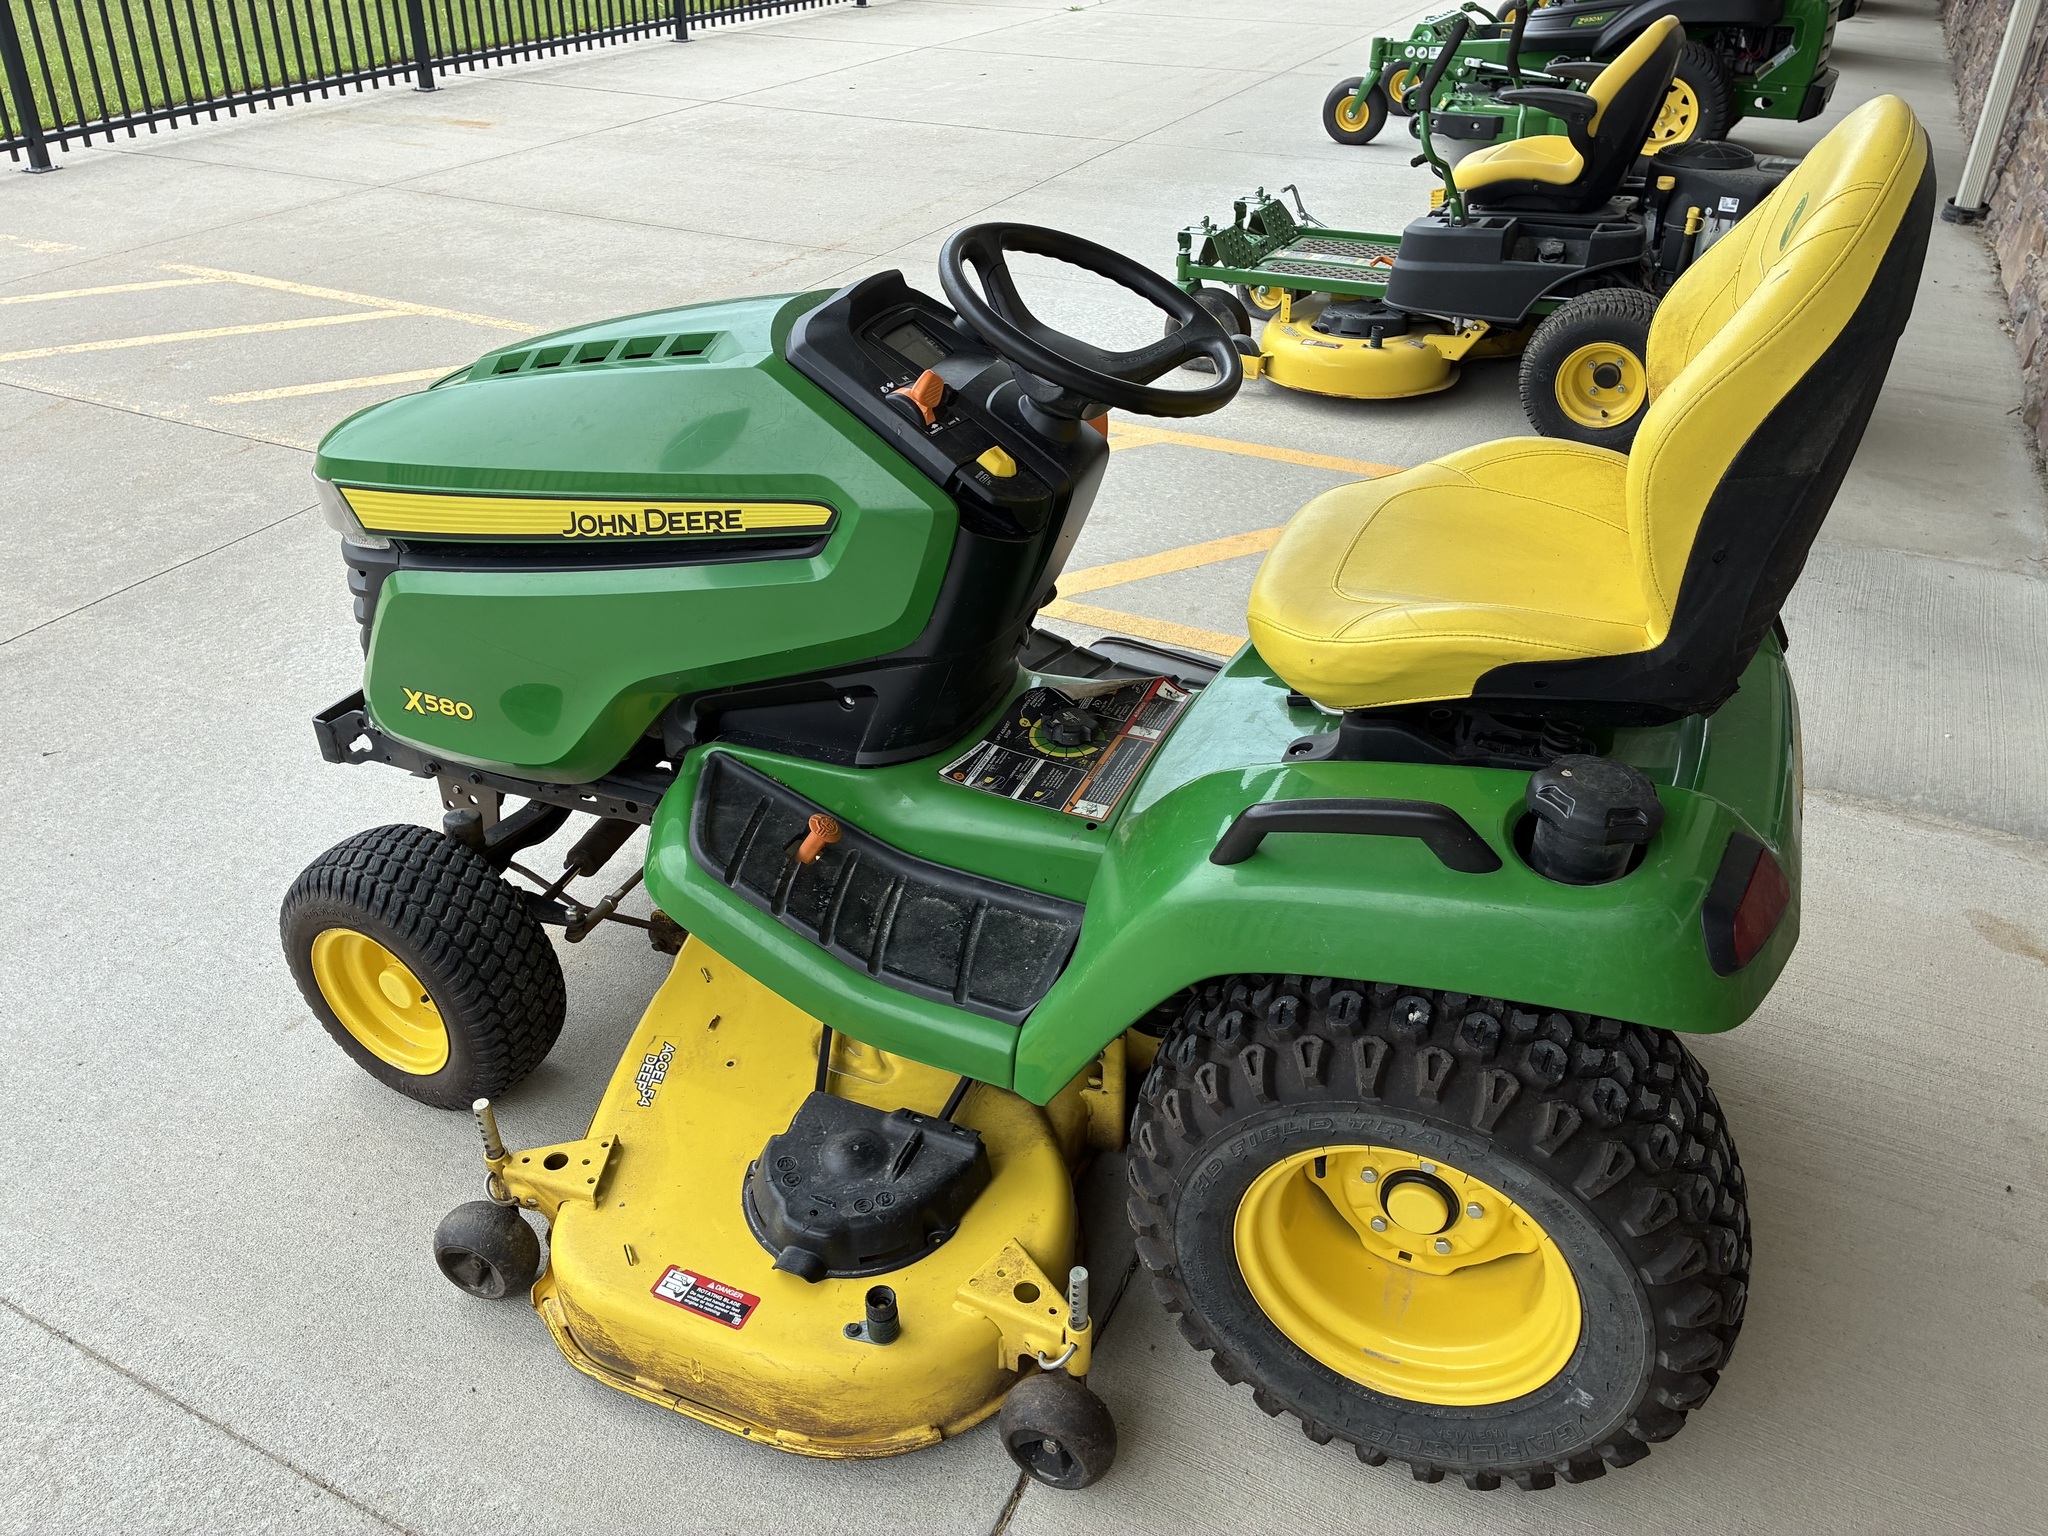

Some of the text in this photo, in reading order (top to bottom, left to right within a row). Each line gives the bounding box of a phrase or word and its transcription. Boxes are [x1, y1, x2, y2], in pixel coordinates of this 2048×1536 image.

[563, 509, 743, 534] JOHN DEERE
[401, 687, 474, 721] X580
[634, 1053, 658, 1091] DEEP
[637, 1041, 676, 1107] ACCEL 54
[1191, 1117, 1486, 1197] HD FIELD TRAX
[697, 1288, 741, 1306] ROTATING BLADE
[715, 1284, 744, 1299] DANGER
[1366, 1420, 1585, 1461] CARLISLE
[1477, 1428, 1508, 1440] MADE
